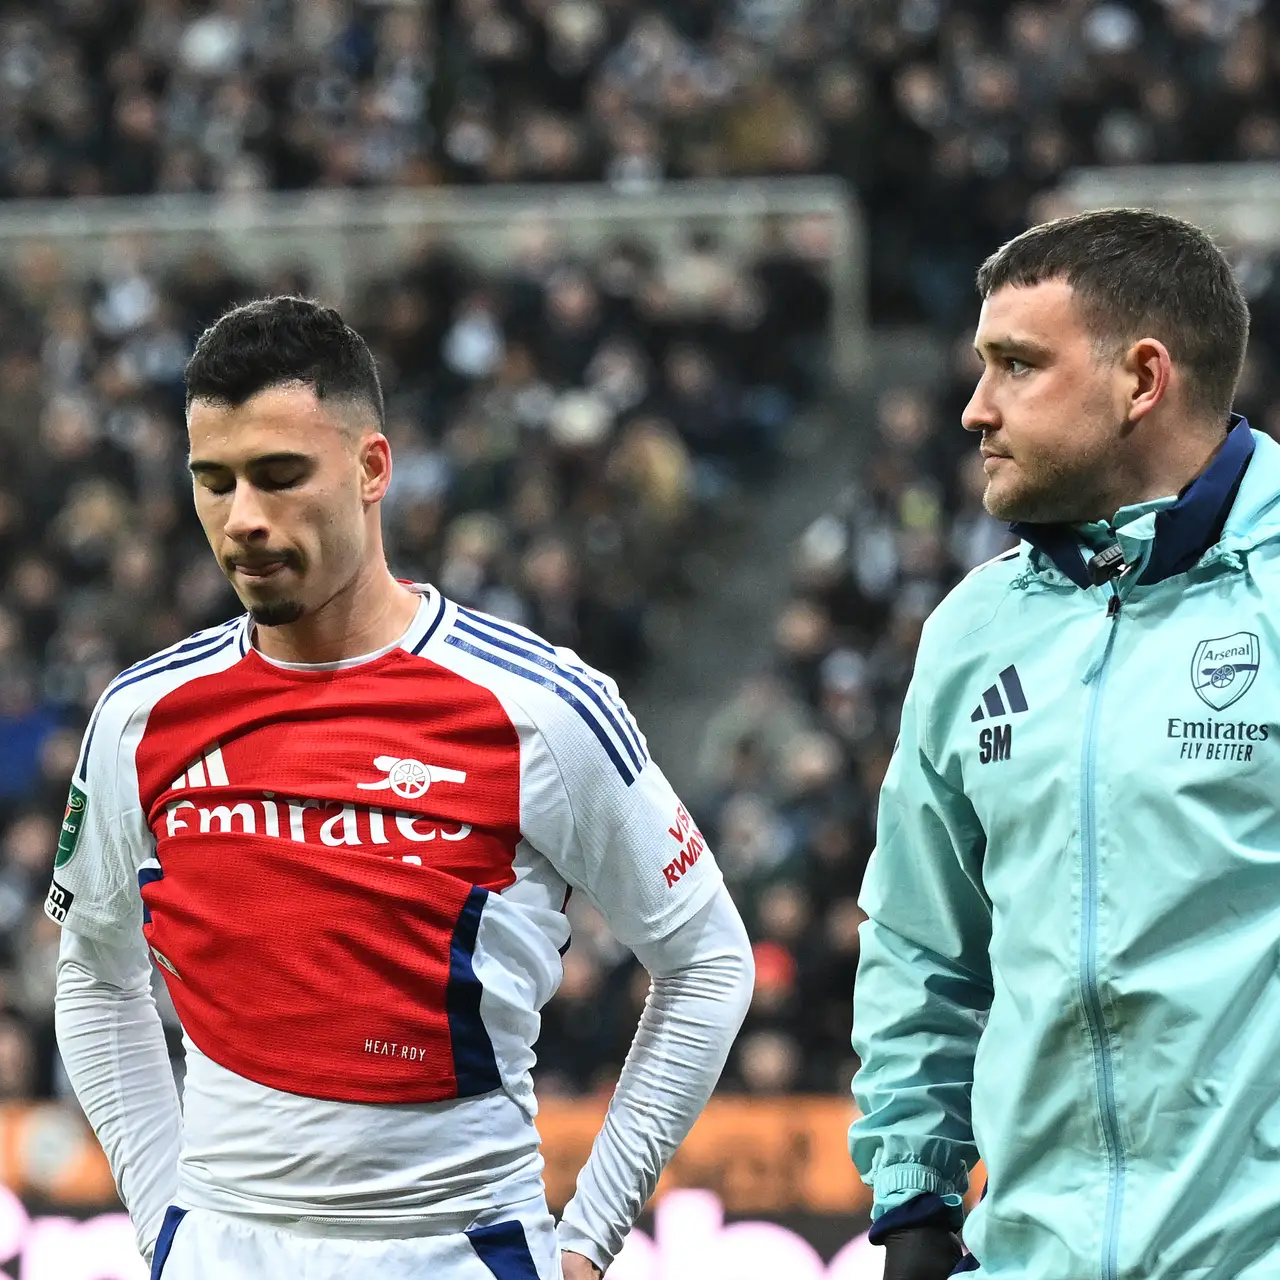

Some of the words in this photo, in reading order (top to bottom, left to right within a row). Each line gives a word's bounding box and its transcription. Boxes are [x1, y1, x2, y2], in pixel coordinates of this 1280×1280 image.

[1204, 643, 1250, 661] Arsenal
[1167, 717, 1269, 742] Emirates
[979, 723, 1012, 765] SM
[1180, 742, 1202, 760] FLY
[1206, 743, 1253, 762] BETTER
[364, 1038, 426, 1062] HEAT.RDY
